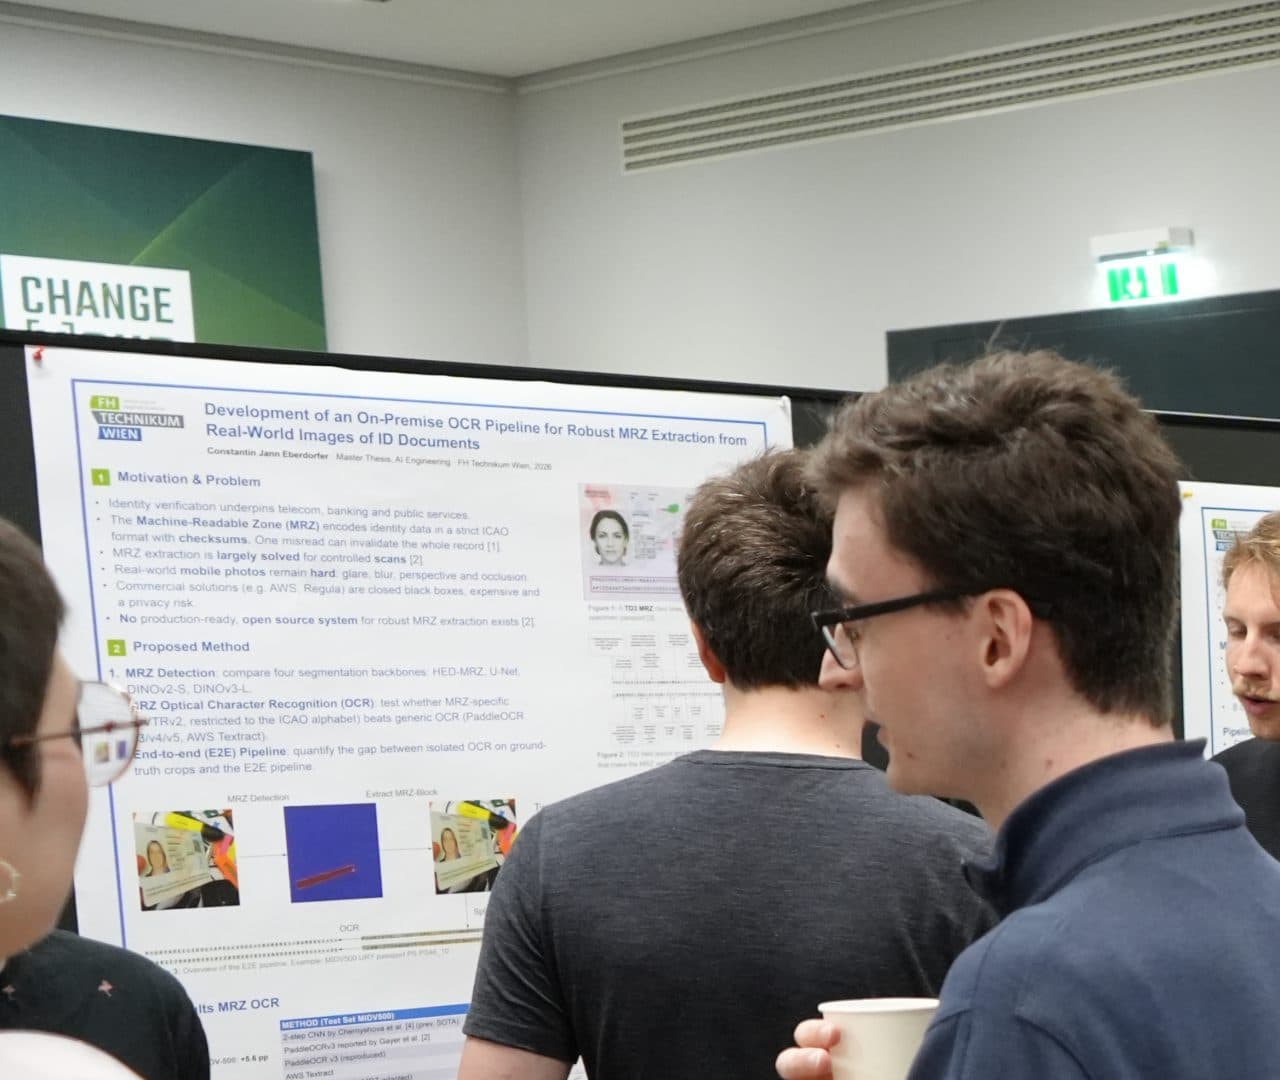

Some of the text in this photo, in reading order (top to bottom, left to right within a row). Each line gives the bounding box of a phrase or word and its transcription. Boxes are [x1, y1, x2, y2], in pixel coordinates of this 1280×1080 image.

[20, 276, 174, 323] CHANGE
[98, 397, 116, 409] FH
[100, 412, 181, 428] TECHNIKUM
[205, 402, 747, 446] Development of an On-Premise OCR Pipeline for Robust MRZ Extraction from
[102, 428, 138, 440] WIEN
[206, 423, 480, 450] Real-World Images of ID Documents
[206, 446, 256, 457] Constantin
[258, 449, 280, 458] Jann
[118, 471, 187, 485] Motivation
[192, 473, 201, 485] &
[206, 474, 260, 487] Problem
[108, 499, 151, 511] Identity
[153, 501, 216, 512] verification
[219, 503, 275, 515] underpins
[326, 506, 368, 518] banking
[370, 508, 391, 517] and
[393, 508, 424, 520] public
[110, 515, 133, 525] The
[136, 516, 249, 528] Machine-Readable
[251, 519, 282, 529] Zone
[285, 520, 320, 532] (MRZ)
[322, 522, 367, 532] encodes
[369, 523, 407, 535] identity
[408, 524, 432, 534] data
[434, 525, 444, 534] in
[455, 526, 480, 535] strict
[481, 526, 509, 536] ICAO
[119, 614, 138, 624] No
[241, 617, 272, 627] open
[274, 617, 315, 625] source
[317, 616, 358, 627] system
[360, 616, 375, 625] for
[377, 616, 410, 626] robust
[412, 616, 439, 626] MRZ
[439, 617, 488, 626] extraction
[490, 617, 520, 626] exists
[114, 641, 250, 655] 2 Proposed Method
[124, 668, 154, 678] MRZ
[222, 670, 270, 680] compare
[273, 668, 294, 677] four
[297, 668, 368, 679] segmentation
[159, 700, 204, 712] Optical
[206, 700, 266, 710] Character
[267, 698, 338, 710] Recognition
[379, 697, 400, 707] test
[401, 697, 442, 707] whether
[442, 697, 509, 709] MRZ-specific
[133, 748, 201, 760] End-to-end
[204, 748, 236, 760] (E2E)
[292, 746, 334, 758] quantify
[337, 745, 354, 755] the
[357, 746, 377, 756] gap
[379, 743, 423, 753] between
[425, 742, 464, 752] isolated
[467, 741, 492, 752] OCR
[509, 740, 546, 752] ground-
[340, 924, 360, 932] OCR
[217, 999, 248, 1013] MRZ
[250, 995, 280, 1010] OCR
[281, 1018, 318, 1030] METHOD
[320, 1016, 341, 1027] (Test
[342, 1014, 356, 1025] Set
